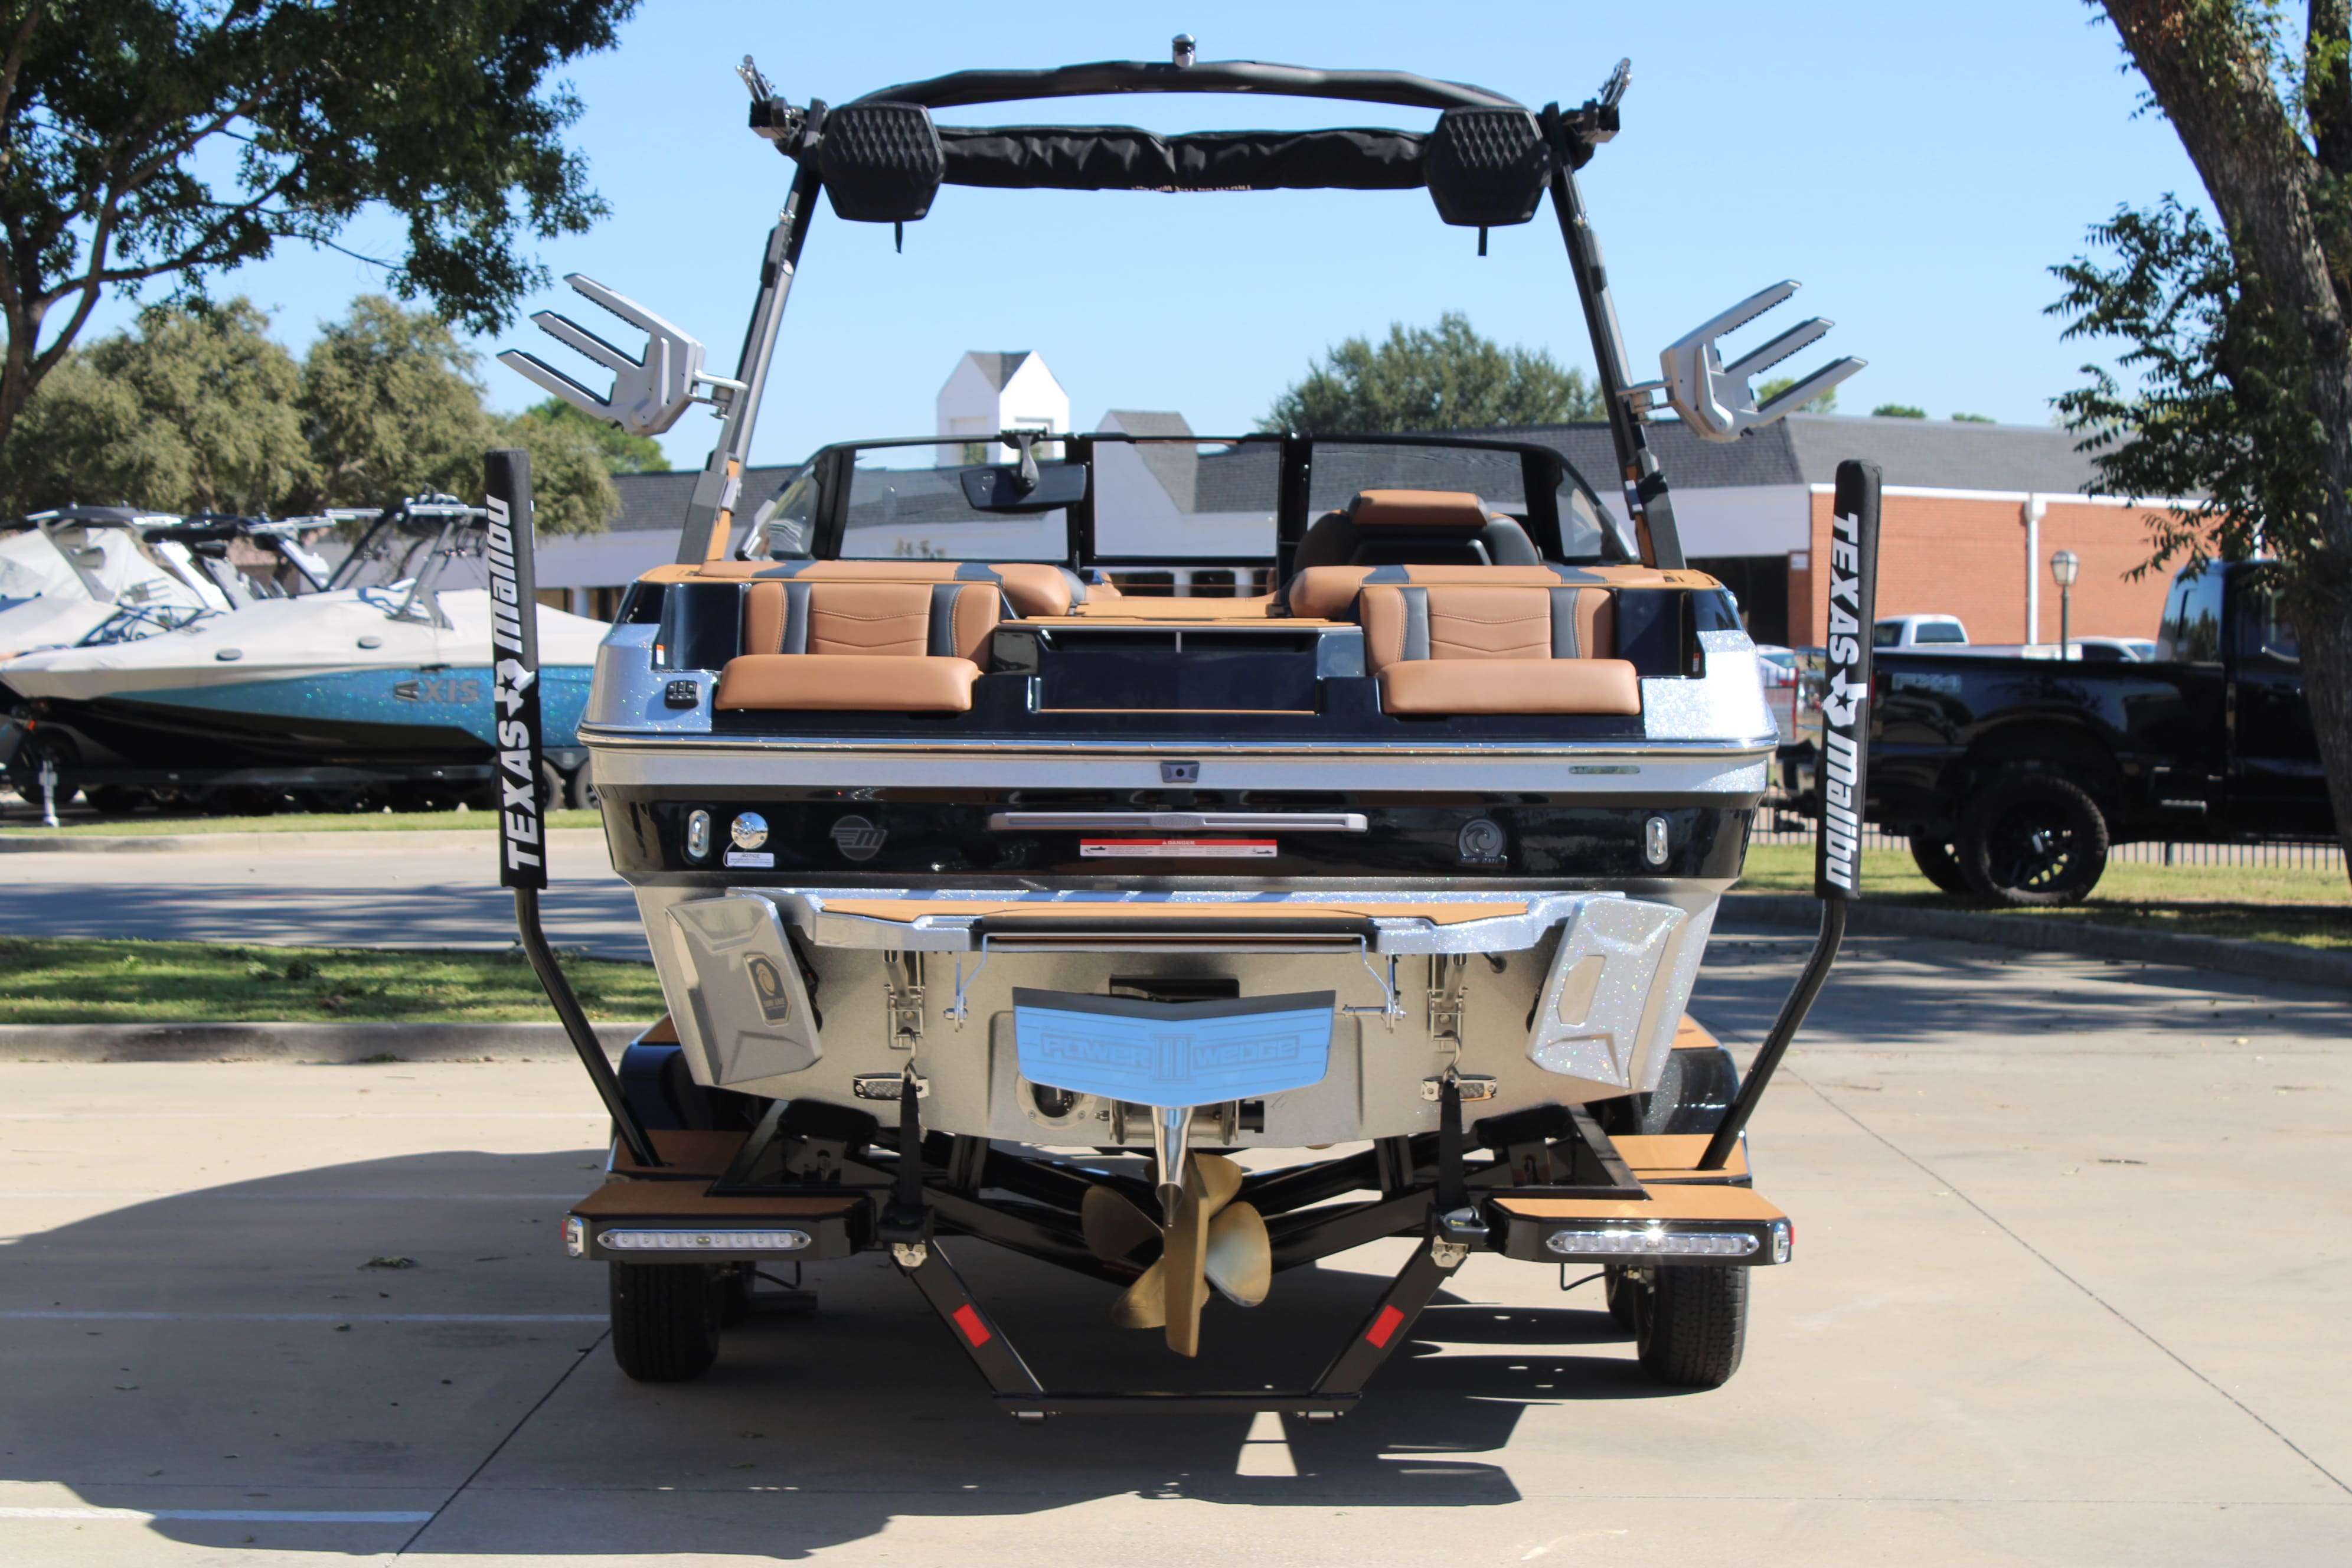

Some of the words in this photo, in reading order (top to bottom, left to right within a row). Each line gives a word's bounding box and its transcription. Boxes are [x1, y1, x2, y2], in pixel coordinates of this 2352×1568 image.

[1830, 512, 1859, 667] TEXAS
[394, 678, 479, 702] AXIS
[499, 720, 540, 871] TEXAS
[1043, 1036, 1151, 1067] POWER
[1197, 1037, 1296, 1067] WEDGE
